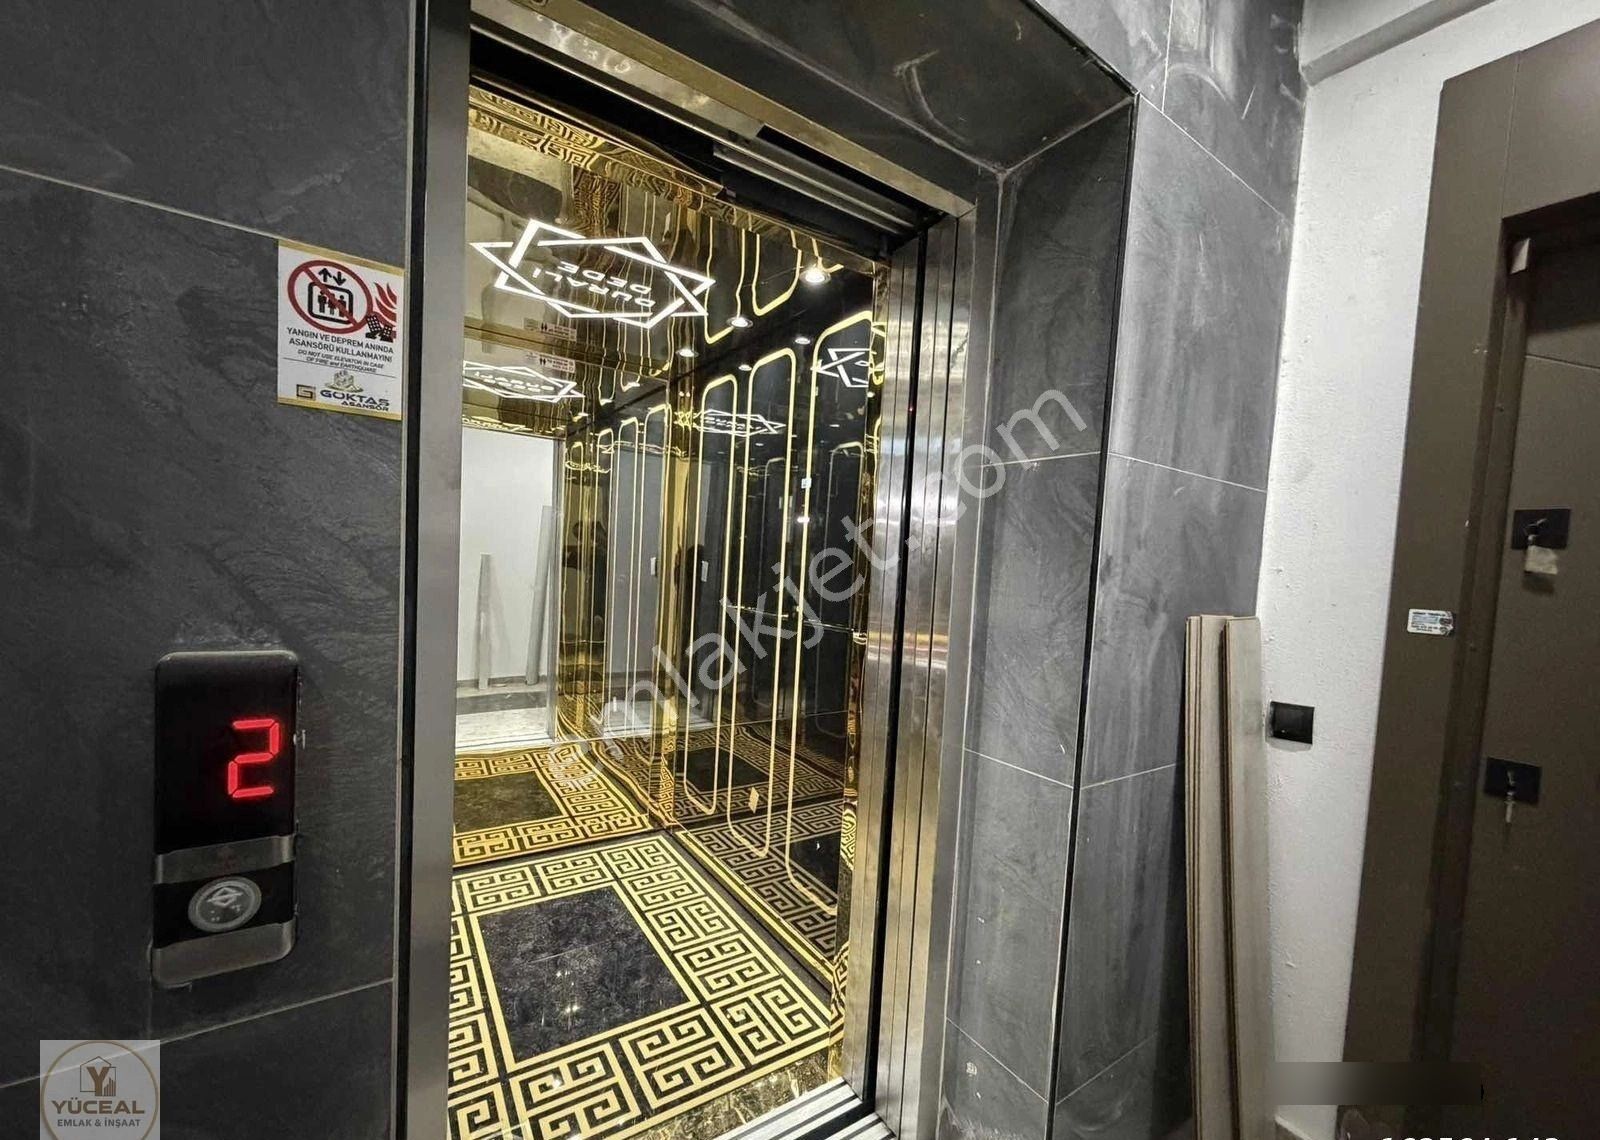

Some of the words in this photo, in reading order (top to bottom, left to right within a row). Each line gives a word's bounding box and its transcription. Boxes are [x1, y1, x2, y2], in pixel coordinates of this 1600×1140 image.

[287, 327, 318, 339] YANGIN
[319, 334, 330, 342] VE
[331, 336, 364, 349] DEPREM
[365, 343, 394, 354] ANINDA
[289, 338, 334, 352] ASANSÖRÜ
[227, 718, 280, 799] 2
